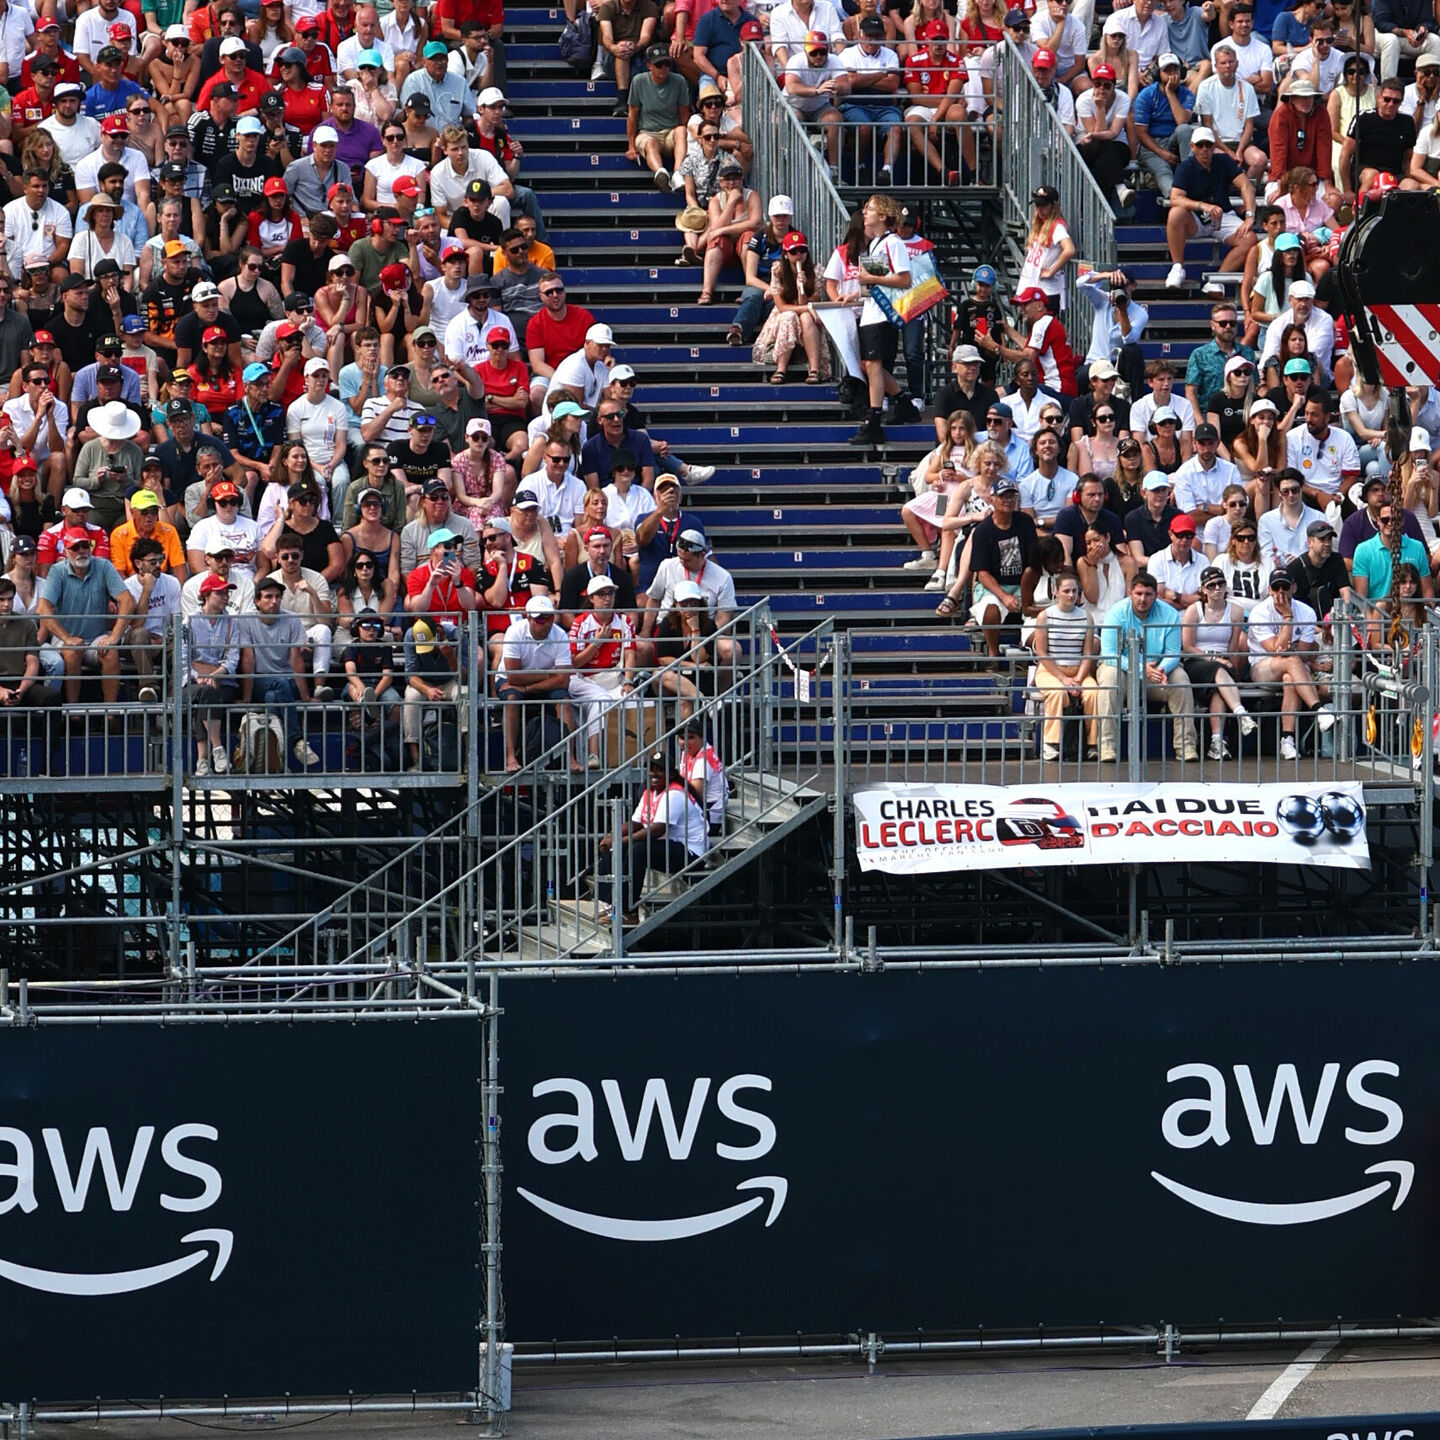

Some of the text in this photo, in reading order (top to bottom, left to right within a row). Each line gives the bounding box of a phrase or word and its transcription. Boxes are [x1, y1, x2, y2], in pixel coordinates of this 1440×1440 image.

[880, 799, 996, 821] CHARLES
[1175, 798, 1265, 816] DUE
[862, 818, 995, 850] LECLERC
[1090, 818, 1280, 839] D'ACCIAIO
[1162, 1060, 1404, 1149] aws
[528, 1074, 777, 1164] aws
